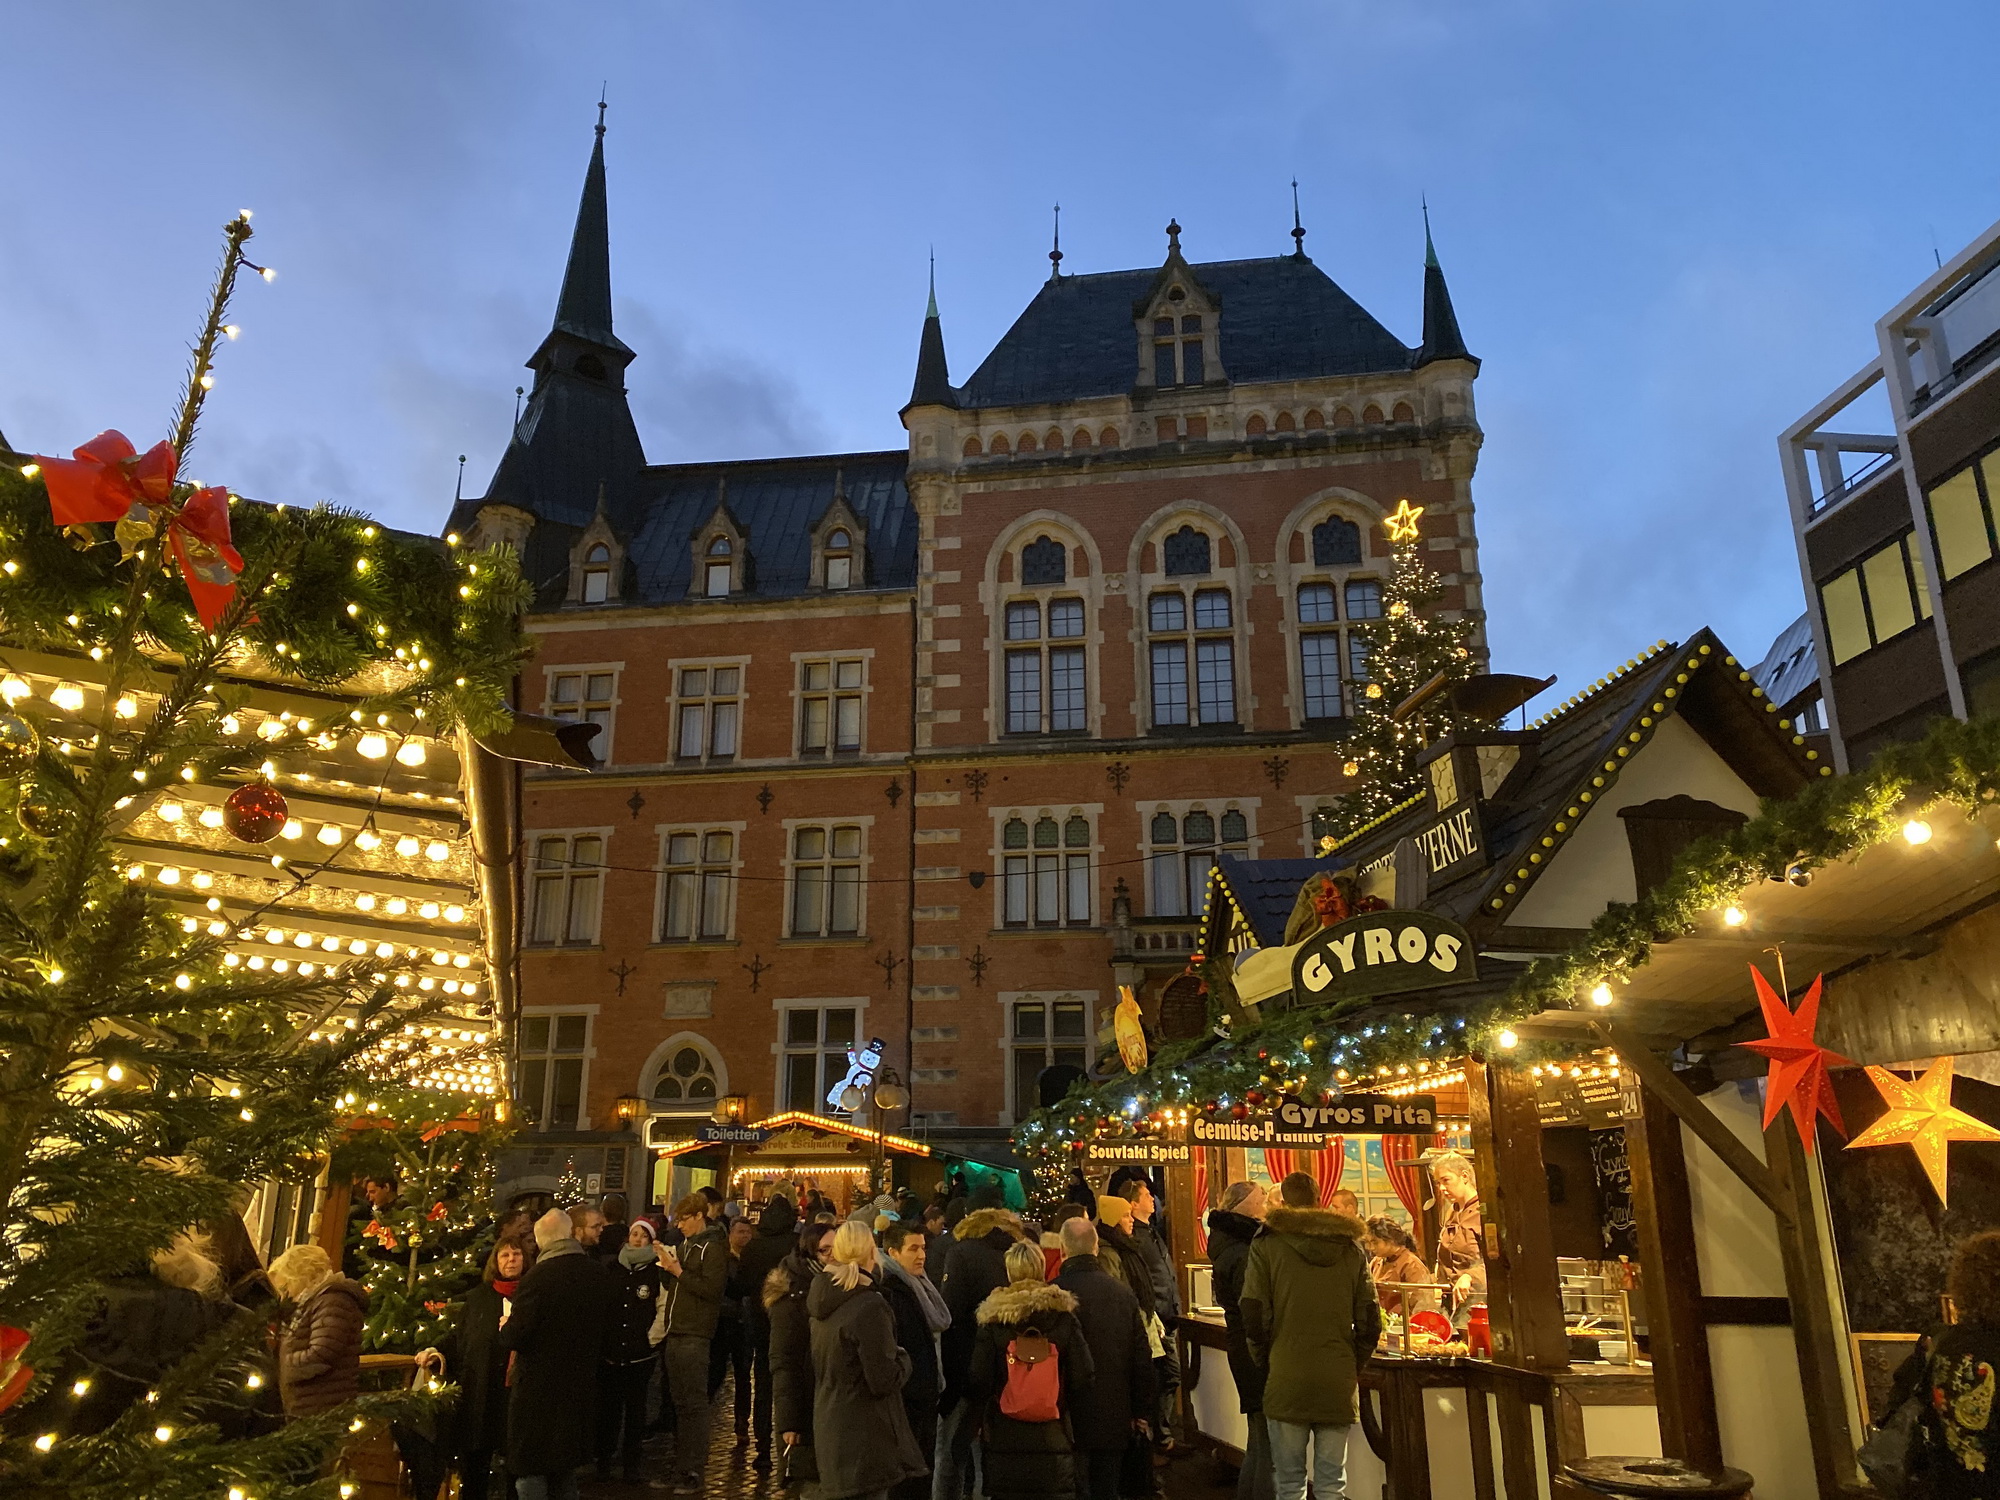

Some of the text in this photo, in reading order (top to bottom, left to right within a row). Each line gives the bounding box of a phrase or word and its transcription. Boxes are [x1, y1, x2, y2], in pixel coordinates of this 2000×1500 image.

[1301, 926, 1463, 993] GYROS
[1623, 1091, 1638, 1114] 24
[1281, 1103, 1433, 1128] Gyros Pita
[705, 1126, 760, 1142] Toiletten
[791, 1138, 848, 1150] Weihnachte
[1088, 1144, 1189, 1162] Souvlaki Spieß
